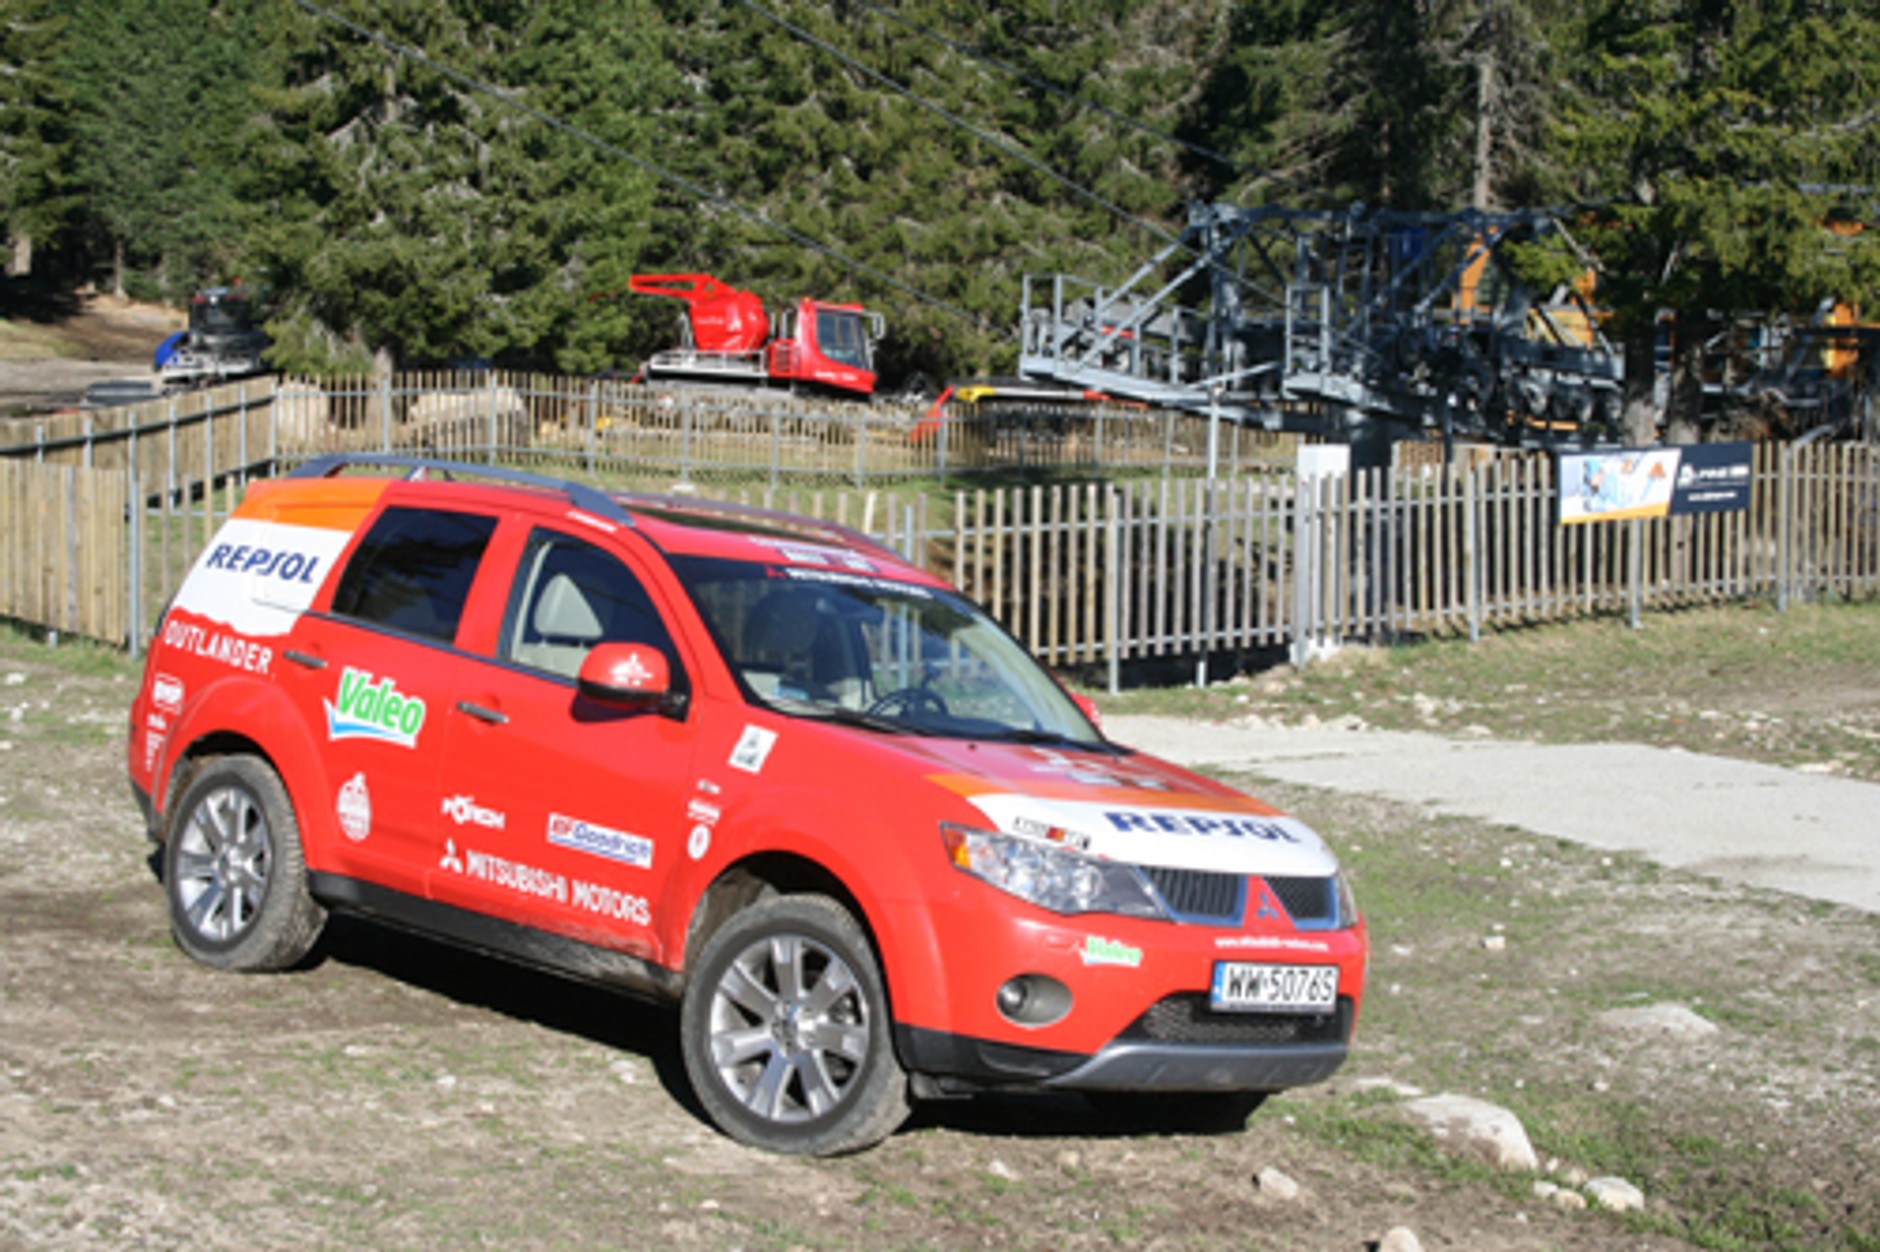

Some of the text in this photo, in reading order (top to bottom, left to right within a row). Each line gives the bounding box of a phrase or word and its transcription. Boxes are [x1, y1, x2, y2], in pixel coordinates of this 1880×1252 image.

[206, 543, 320, 583] REPSOL
[164, 620, 273, 674] OUTLANDER
[336, 667, 424, 736] Valeo
[1103, 812, 1301, 843] REPSOL
[466, 849, 652, 926] MITSUBISHI MOTORS
